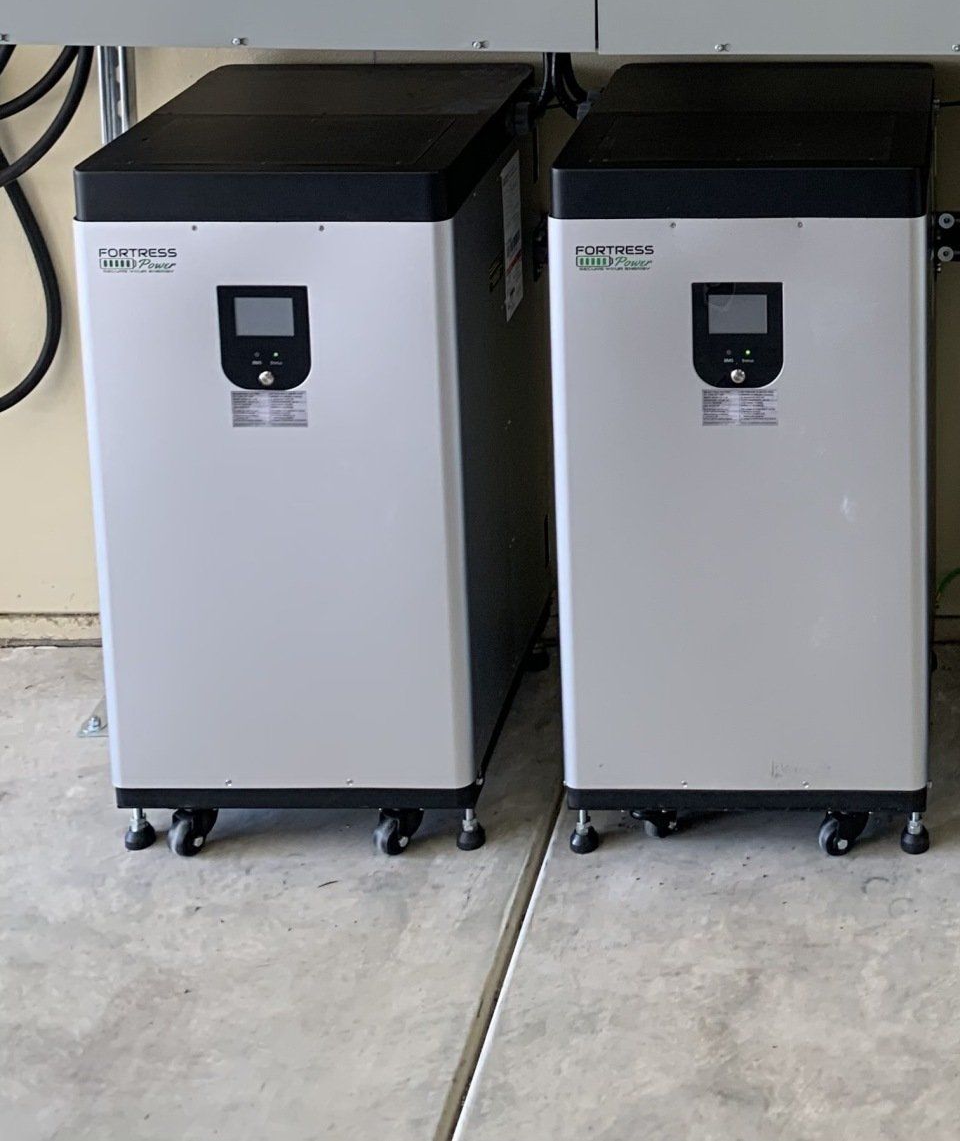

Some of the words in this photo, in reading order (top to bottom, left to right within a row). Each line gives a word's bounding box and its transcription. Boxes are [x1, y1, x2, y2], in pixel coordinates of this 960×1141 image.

[98, 248, 177, 258] FORTRESS
[575, 245, 654, 255] FORTRESS
[138, 258, 176, 269] Power
[614, 256, 652, 267] Power
